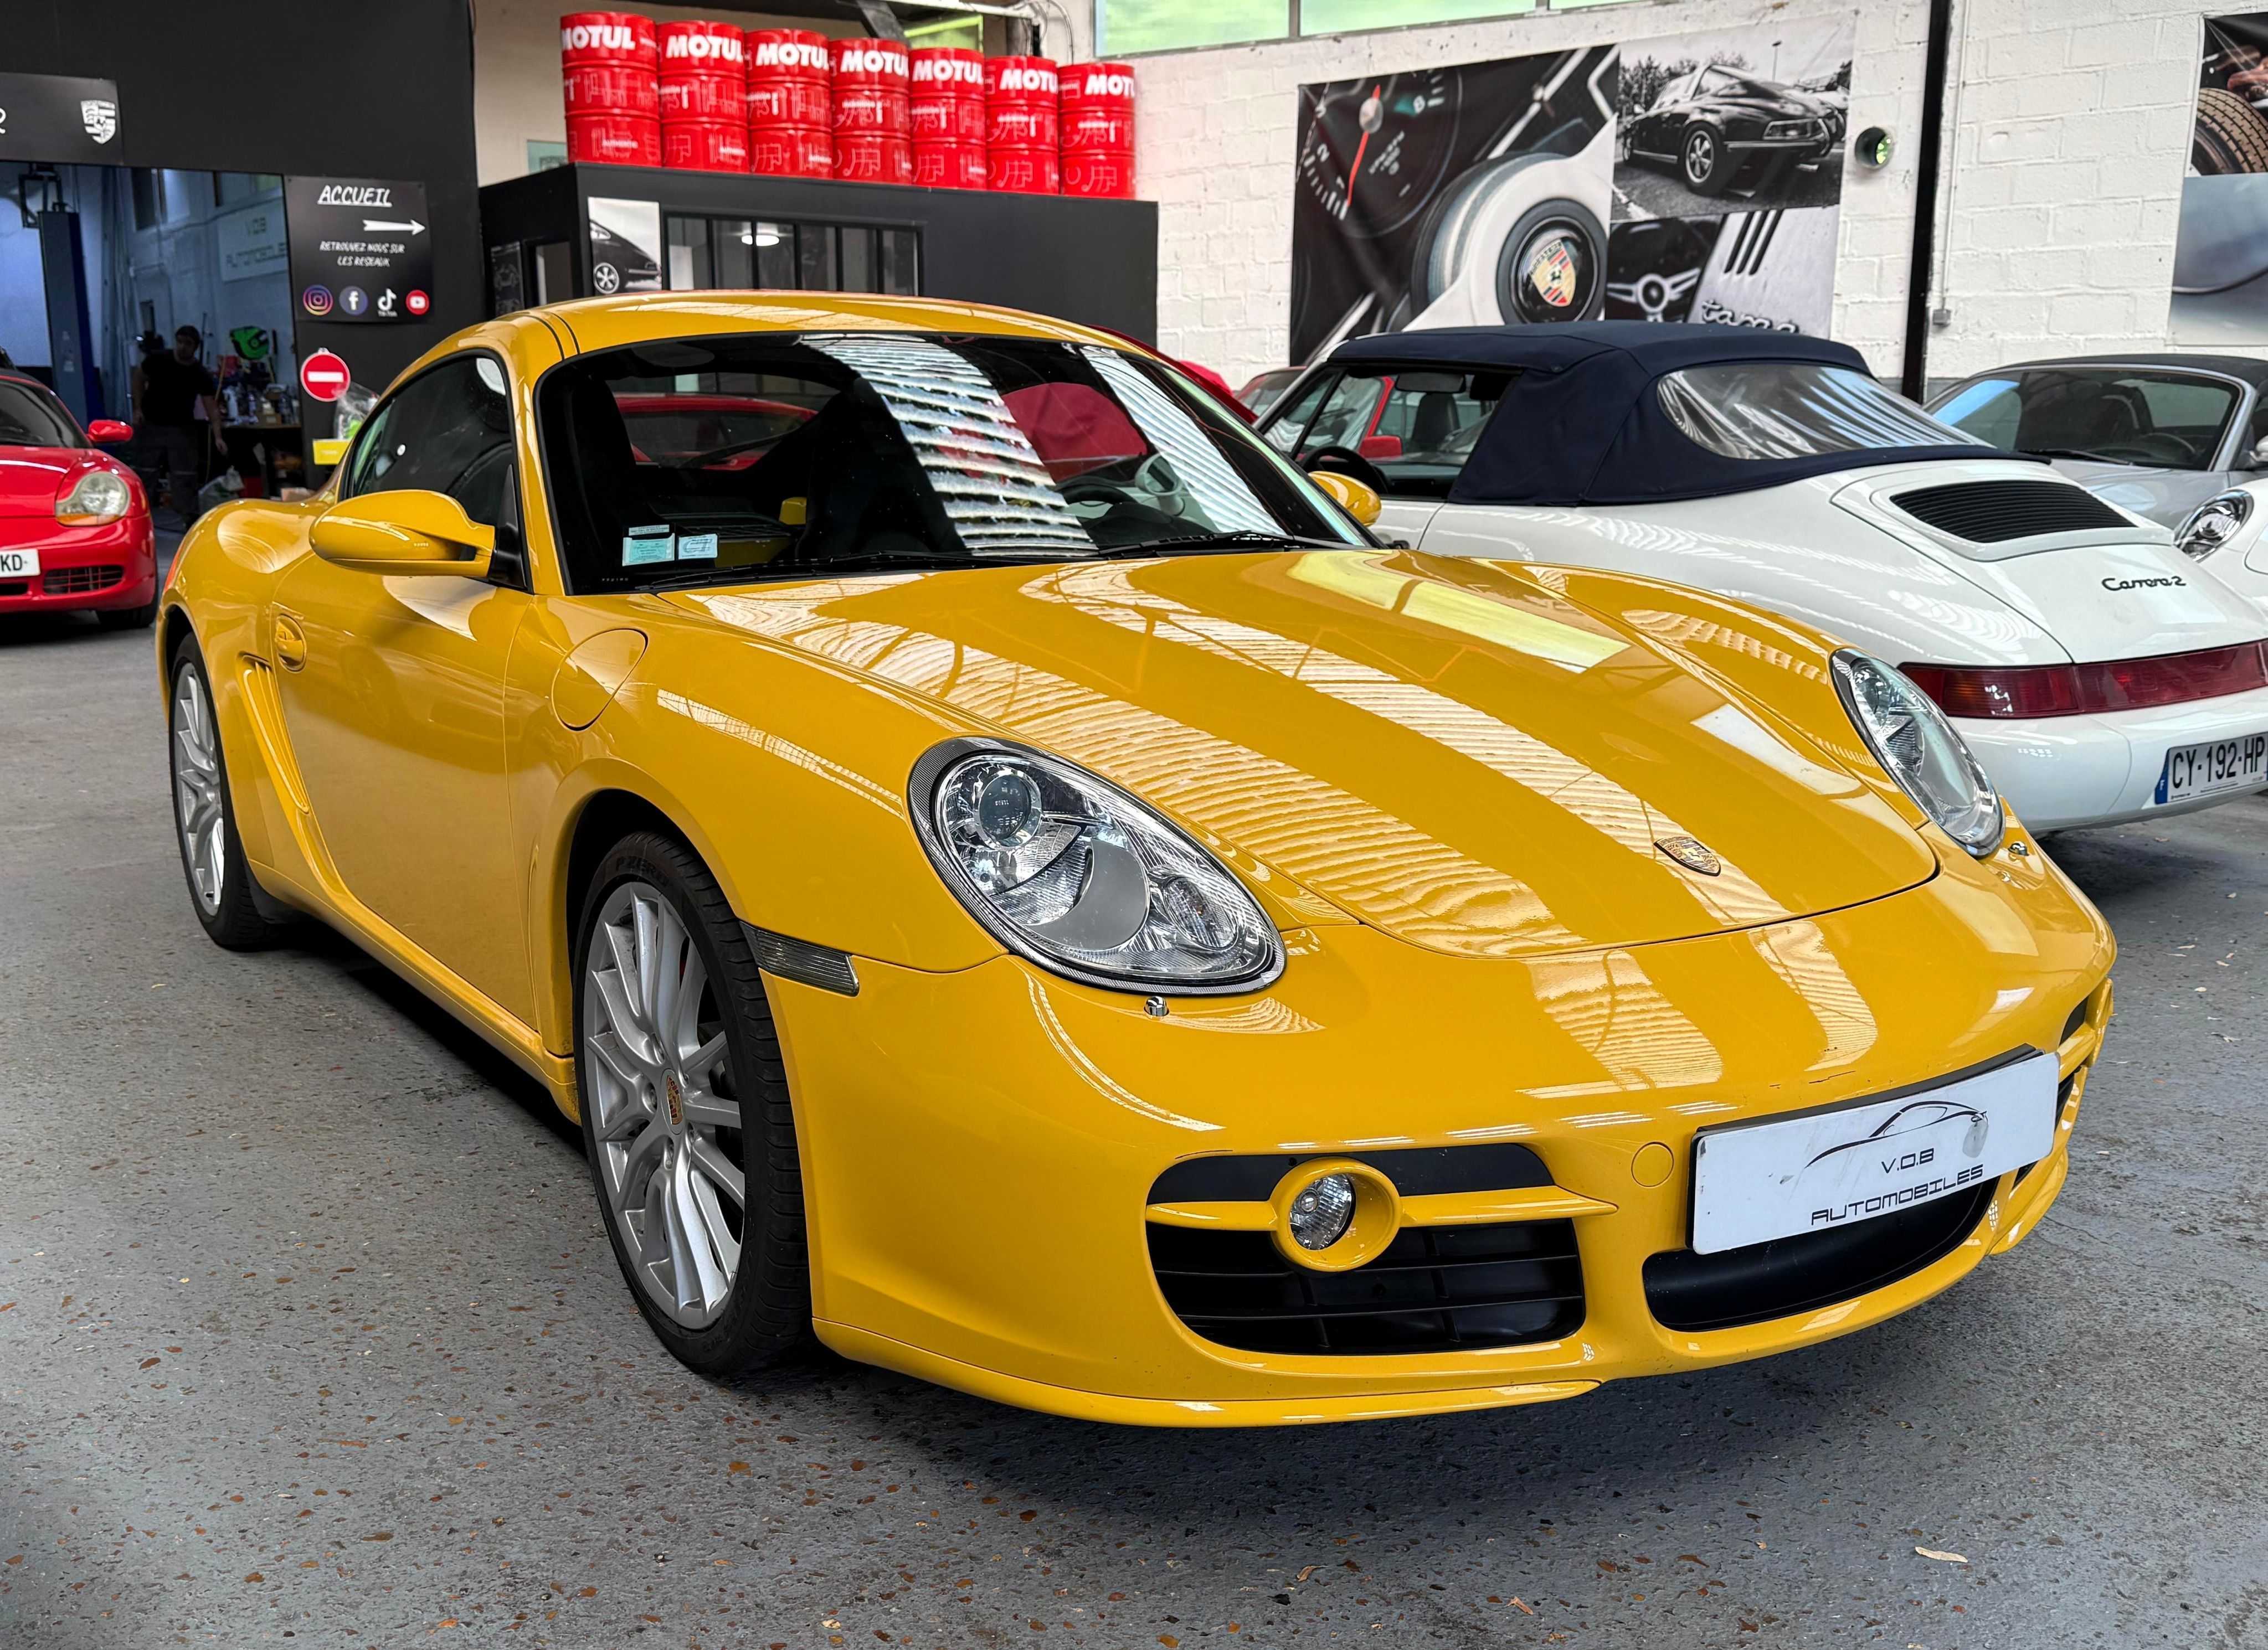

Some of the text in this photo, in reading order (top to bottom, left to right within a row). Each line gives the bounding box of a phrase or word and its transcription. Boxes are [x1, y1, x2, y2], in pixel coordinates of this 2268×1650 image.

[666, 34, 744, 63] MOTUL
[318, 185, 392, 207] ACCUEIL
[2101, 575, 2187, 591] Carrera 2
[2172, 736, 2265, 788] CY-192-HP
[1881, 1148, 1934, 1174] V.O.B
[1812, 1164, 1984, 1225] AUTOMOBILES
